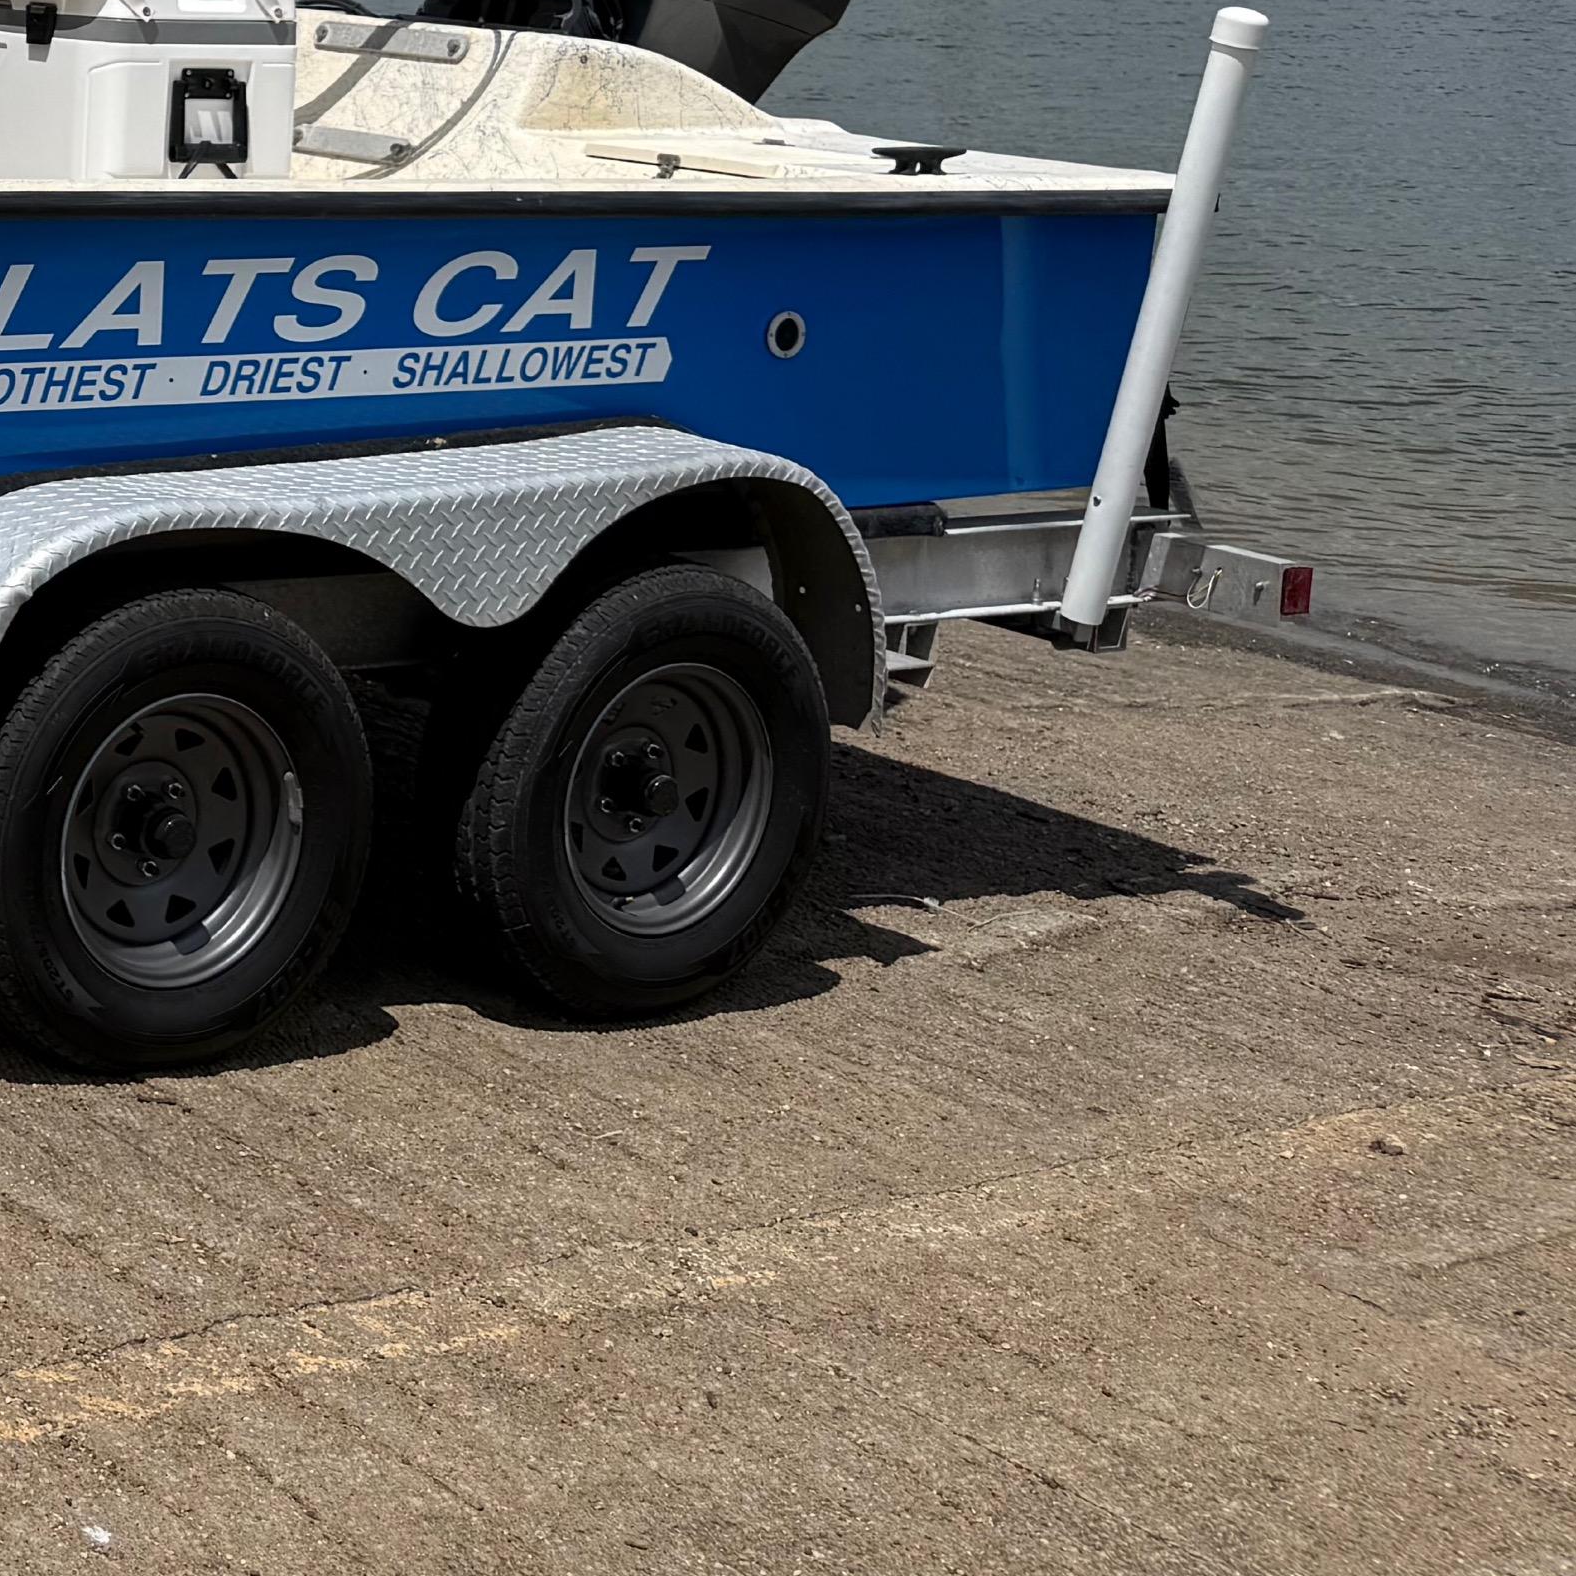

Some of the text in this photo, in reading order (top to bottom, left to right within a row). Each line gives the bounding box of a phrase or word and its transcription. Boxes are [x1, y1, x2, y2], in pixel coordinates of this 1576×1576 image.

[412, 245, 712, 338] CAT
[199, 355, 352, 398] DRIEST
[391, 342, 657, 388] SHALLOWEST
